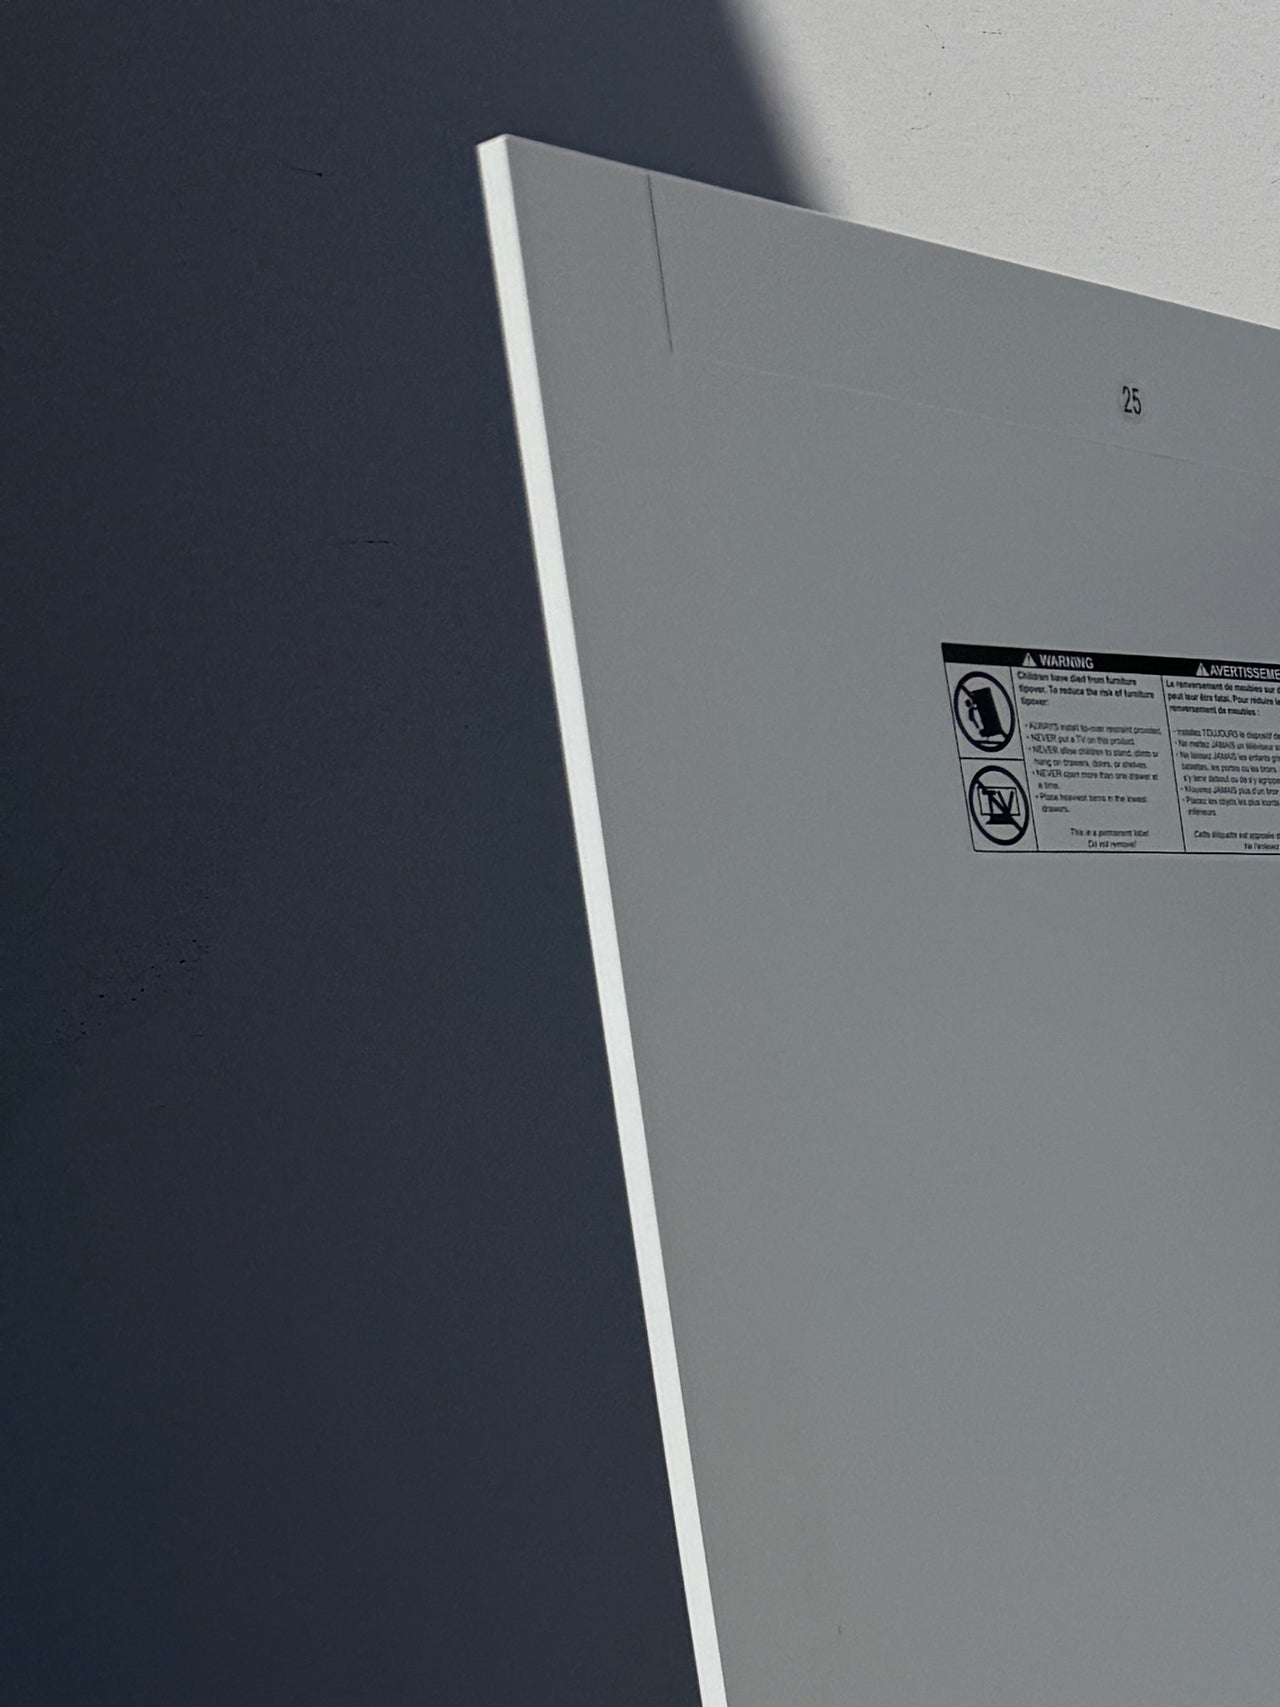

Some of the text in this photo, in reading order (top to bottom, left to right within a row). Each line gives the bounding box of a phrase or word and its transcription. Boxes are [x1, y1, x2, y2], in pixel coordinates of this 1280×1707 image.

[1122, 386, 1141, 415] 25
[1040, 654, 1094, 669] WARNING
[1017, 671, 1048, 680] Children
[1048, 685, 1058, 694] To
[1059, 687, 1084, 695] reduce
[1086, 688, 1098, 696] the
[1115, 689, 1122, 697] of
[1166, 680, 1174, 688] Le
[1224, 683, 1233, 691] de
[1264, 686, 1275, 694] sur
[1232, 694, 1248, 704] Pour
[1275, 698, 1280, 706] le
[1218, 706, 1226, 714] de
[1031, 734, 1056, 742] NEVER
[1076, 735, 1085, 743] TV
[1032, 745, 1059, 754] NEVER
[1036, 769, 1061, 778] NEVER
